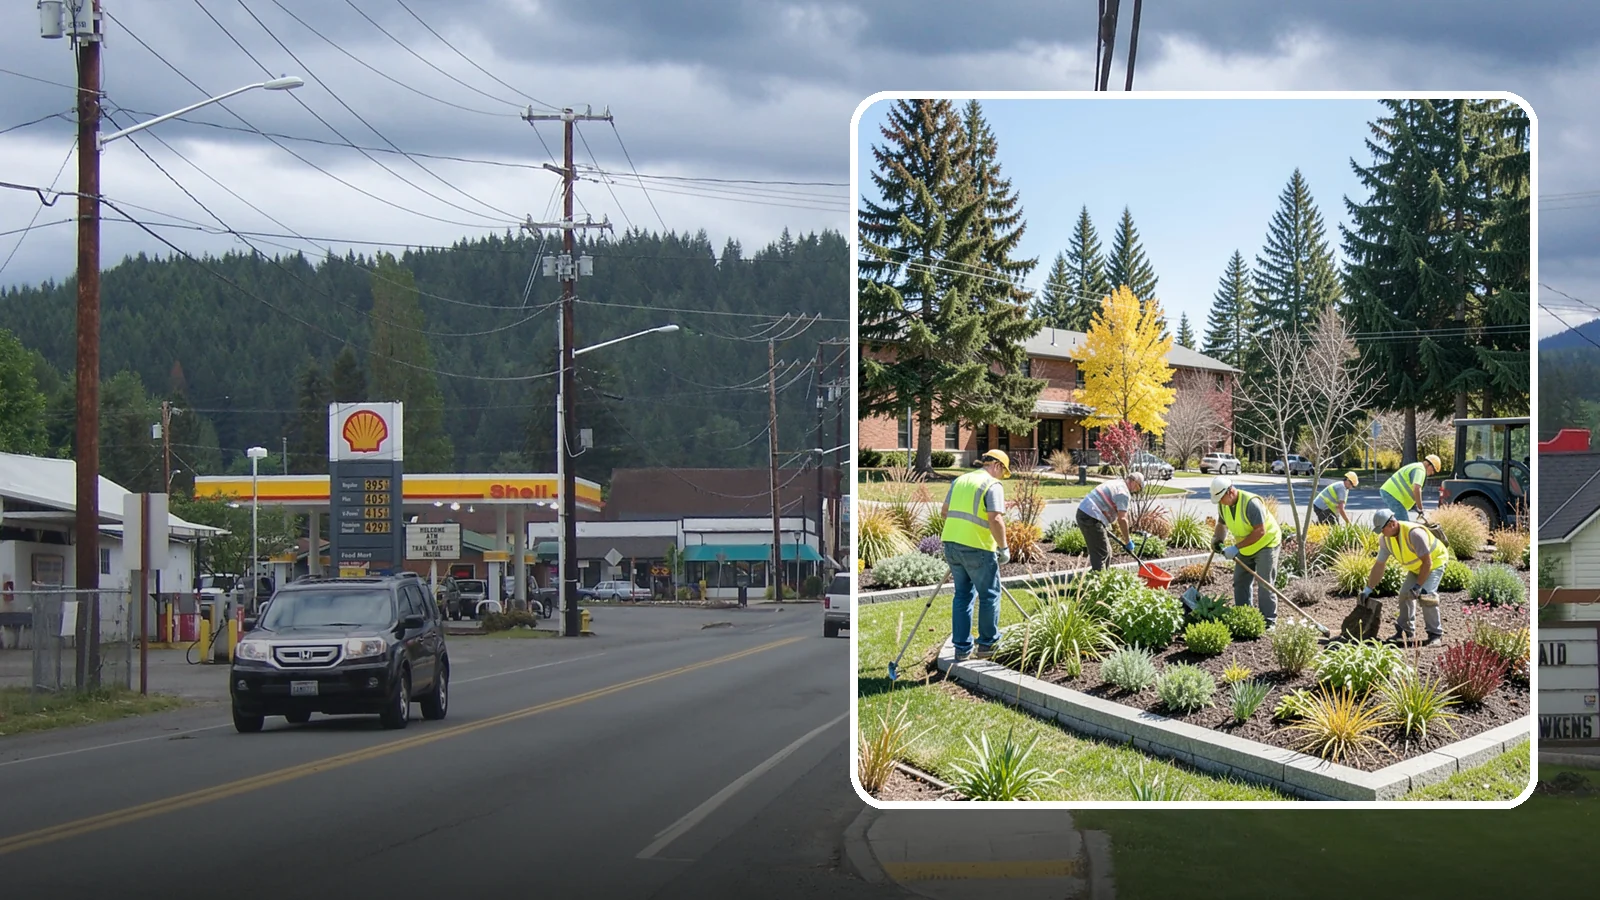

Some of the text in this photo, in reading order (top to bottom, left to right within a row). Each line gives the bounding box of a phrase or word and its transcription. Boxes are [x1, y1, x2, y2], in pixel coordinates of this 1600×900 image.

[366, 480, 383, 490] 395
[490, 484, 547, 499] Shell
[366, 494, 383, 504] 405
[366, 508, 383, 518] 415
[366, 522, 383, 532] 429
